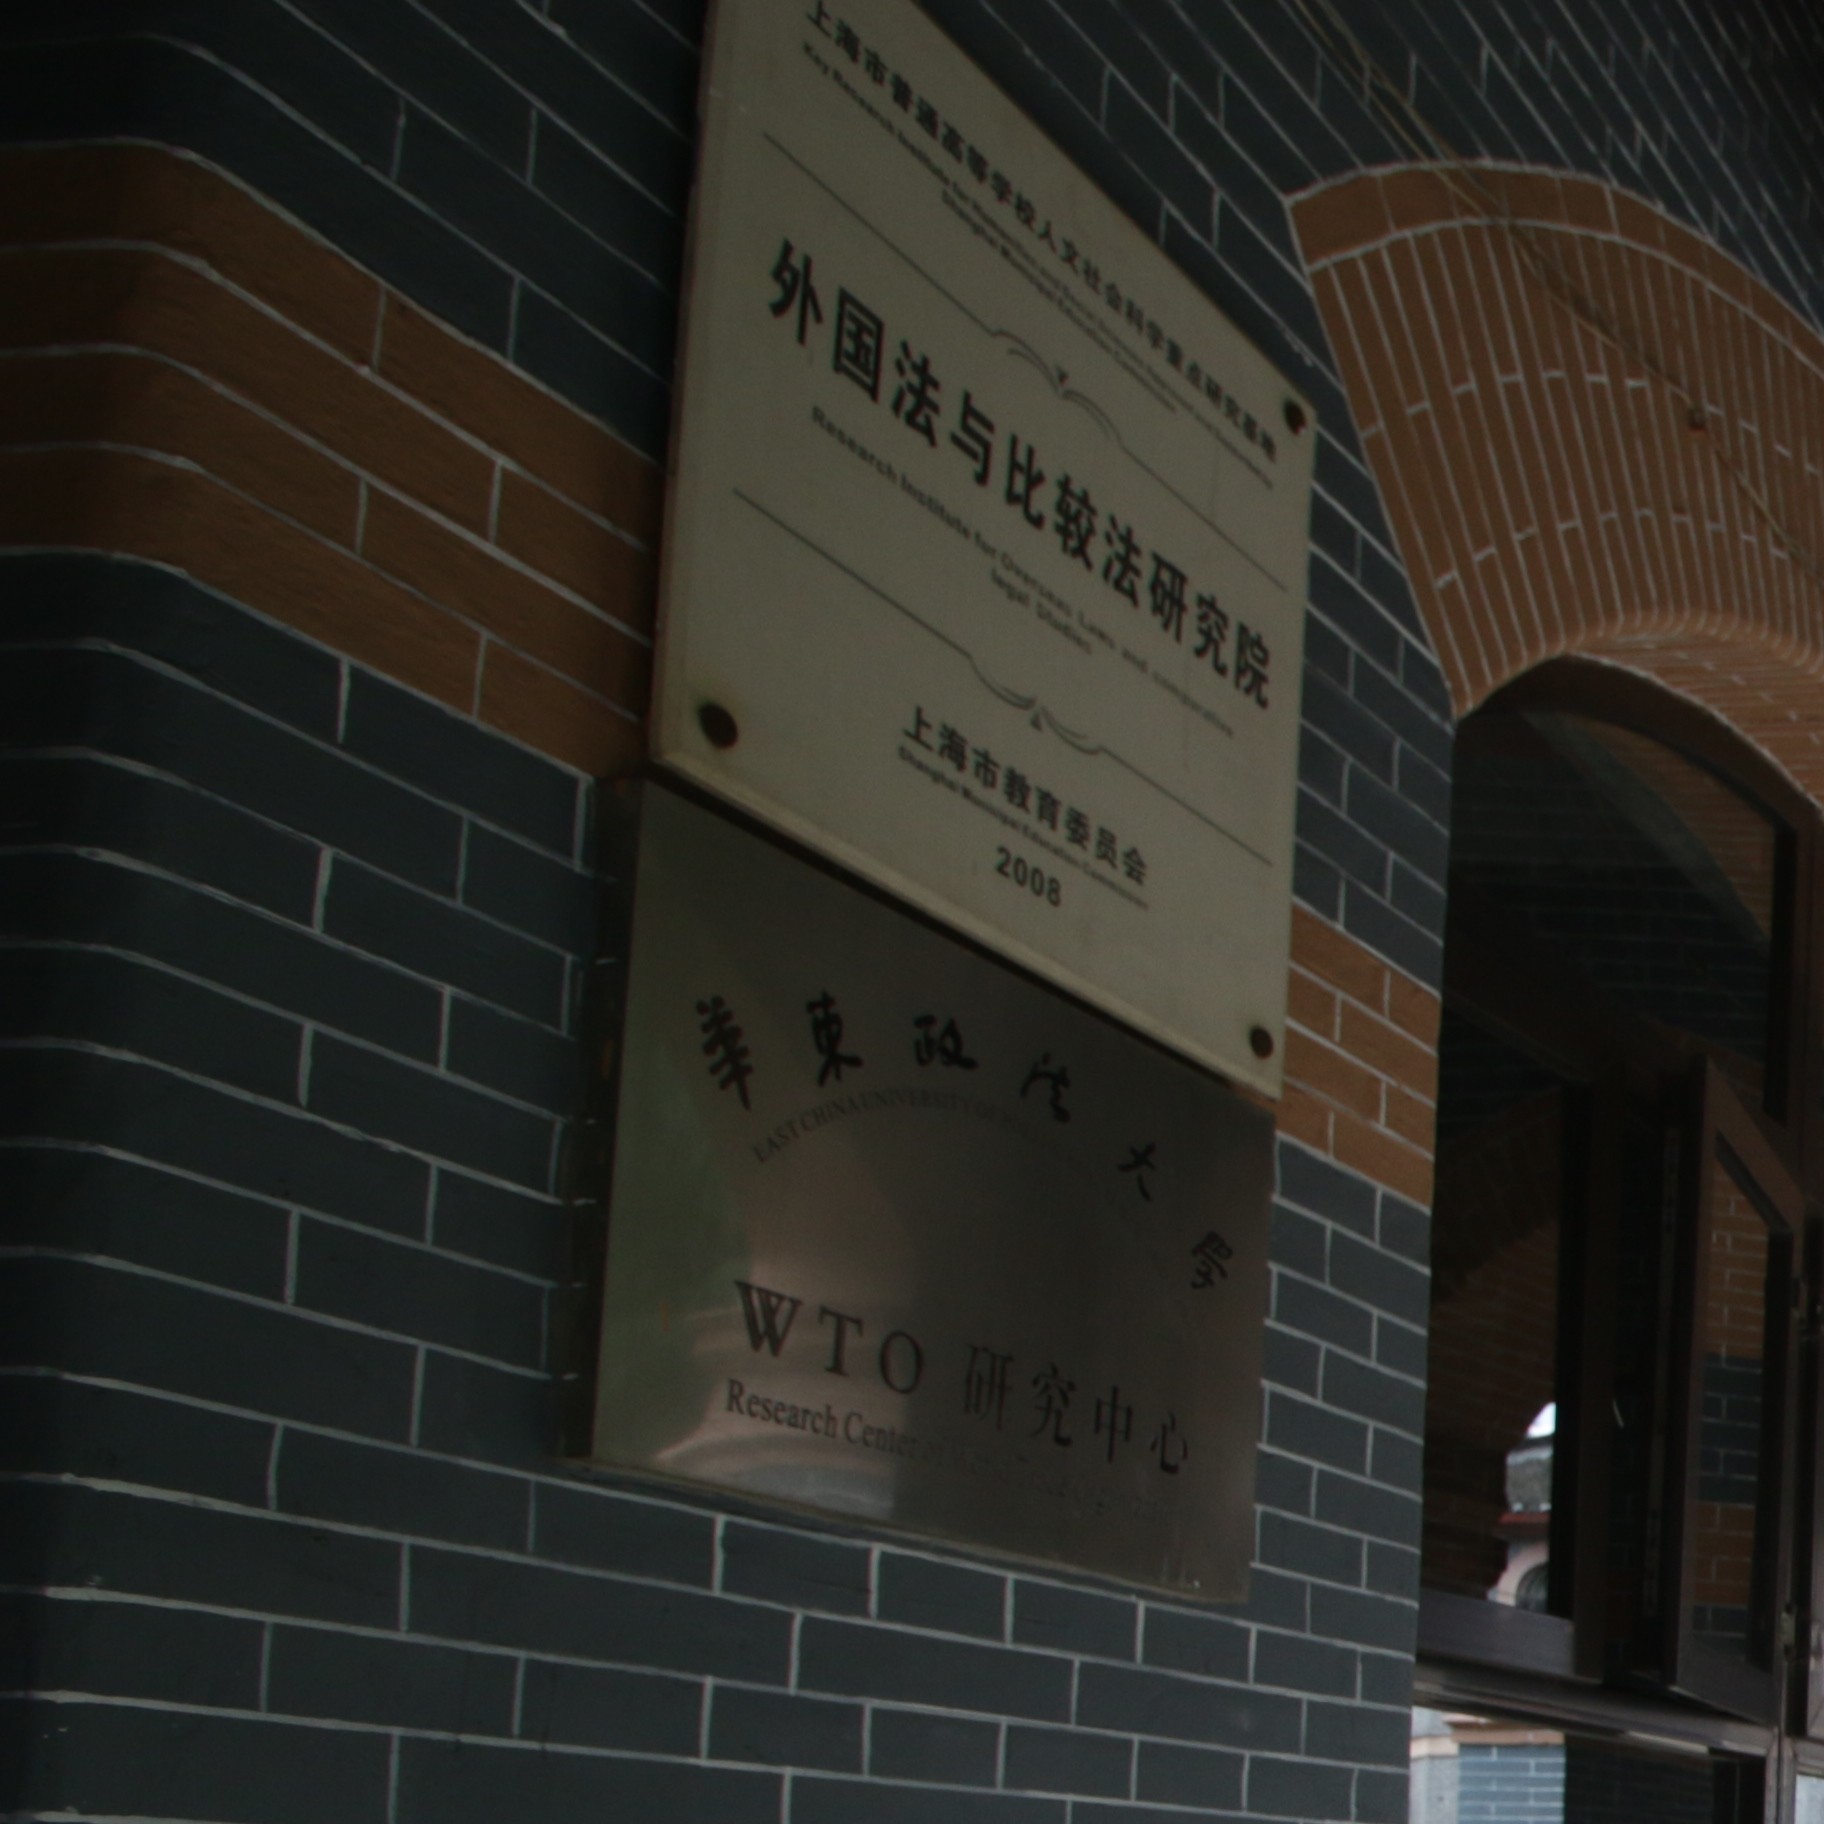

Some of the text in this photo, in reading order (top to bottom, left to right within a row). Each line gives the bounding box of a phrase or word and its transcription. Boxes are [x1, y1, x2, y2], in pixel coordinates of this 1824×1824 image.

[769, 237, 1271, 710] 外国法与比较法研究院
[812, 405, 898, 483] Research
[900, 473, 970, 539] Institute
[902, 704, 1148, 886] 上海市教育委员会
[994, 844, 1062, 908] 2008
[752, 1118, 803, 1164] EAST
[800, 1095, 860, 1133] CHINA
[726, 1378, 838, 1439] Research
[843, 1411, 918, 1459] Center
[733, 1279, 1188, 1476] WTO 研究中心
